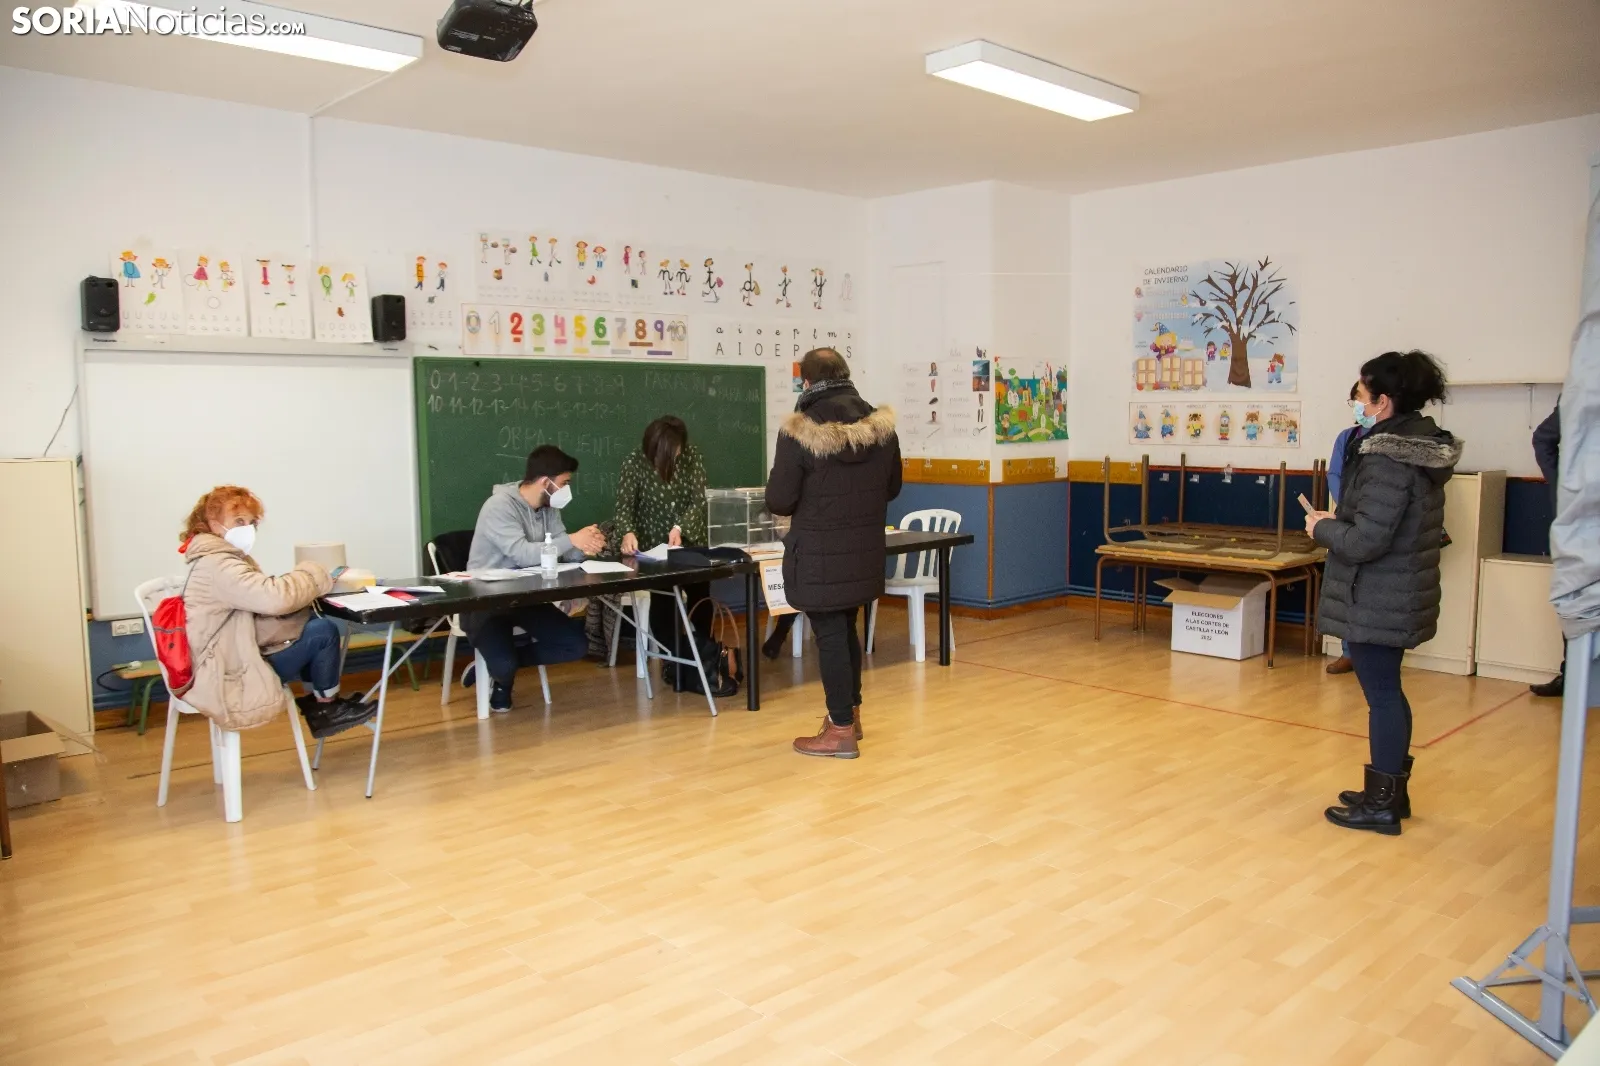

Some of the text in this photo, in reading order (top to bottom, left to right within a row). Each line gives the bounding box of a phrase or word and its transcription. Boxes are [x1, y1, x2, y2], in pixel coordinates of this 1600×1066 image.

[1144, 265, 1188, 275] CALENDARIO
[1154, 275, 1189, 284] INVIERNO
[466, 311, 481, 334] 0
[489, 311, 500, 334] 1
[510, 312, 523, 335] 2
[532, 313, 545, 335] 3
[554, 315, 566, 337] 4
[574, 315, 587, 338] 5
[594, 317, 607, 338] 6
[615, 318, 627, 339] 7
[635, 319, 647, 340] 8
[654, 320, 664, 340] 9
[667, 320, 686, 341] 10
[1191, 611, 1224, 620] ELECCIONES
[1185, 625, 1210, 633] CASTILLA
